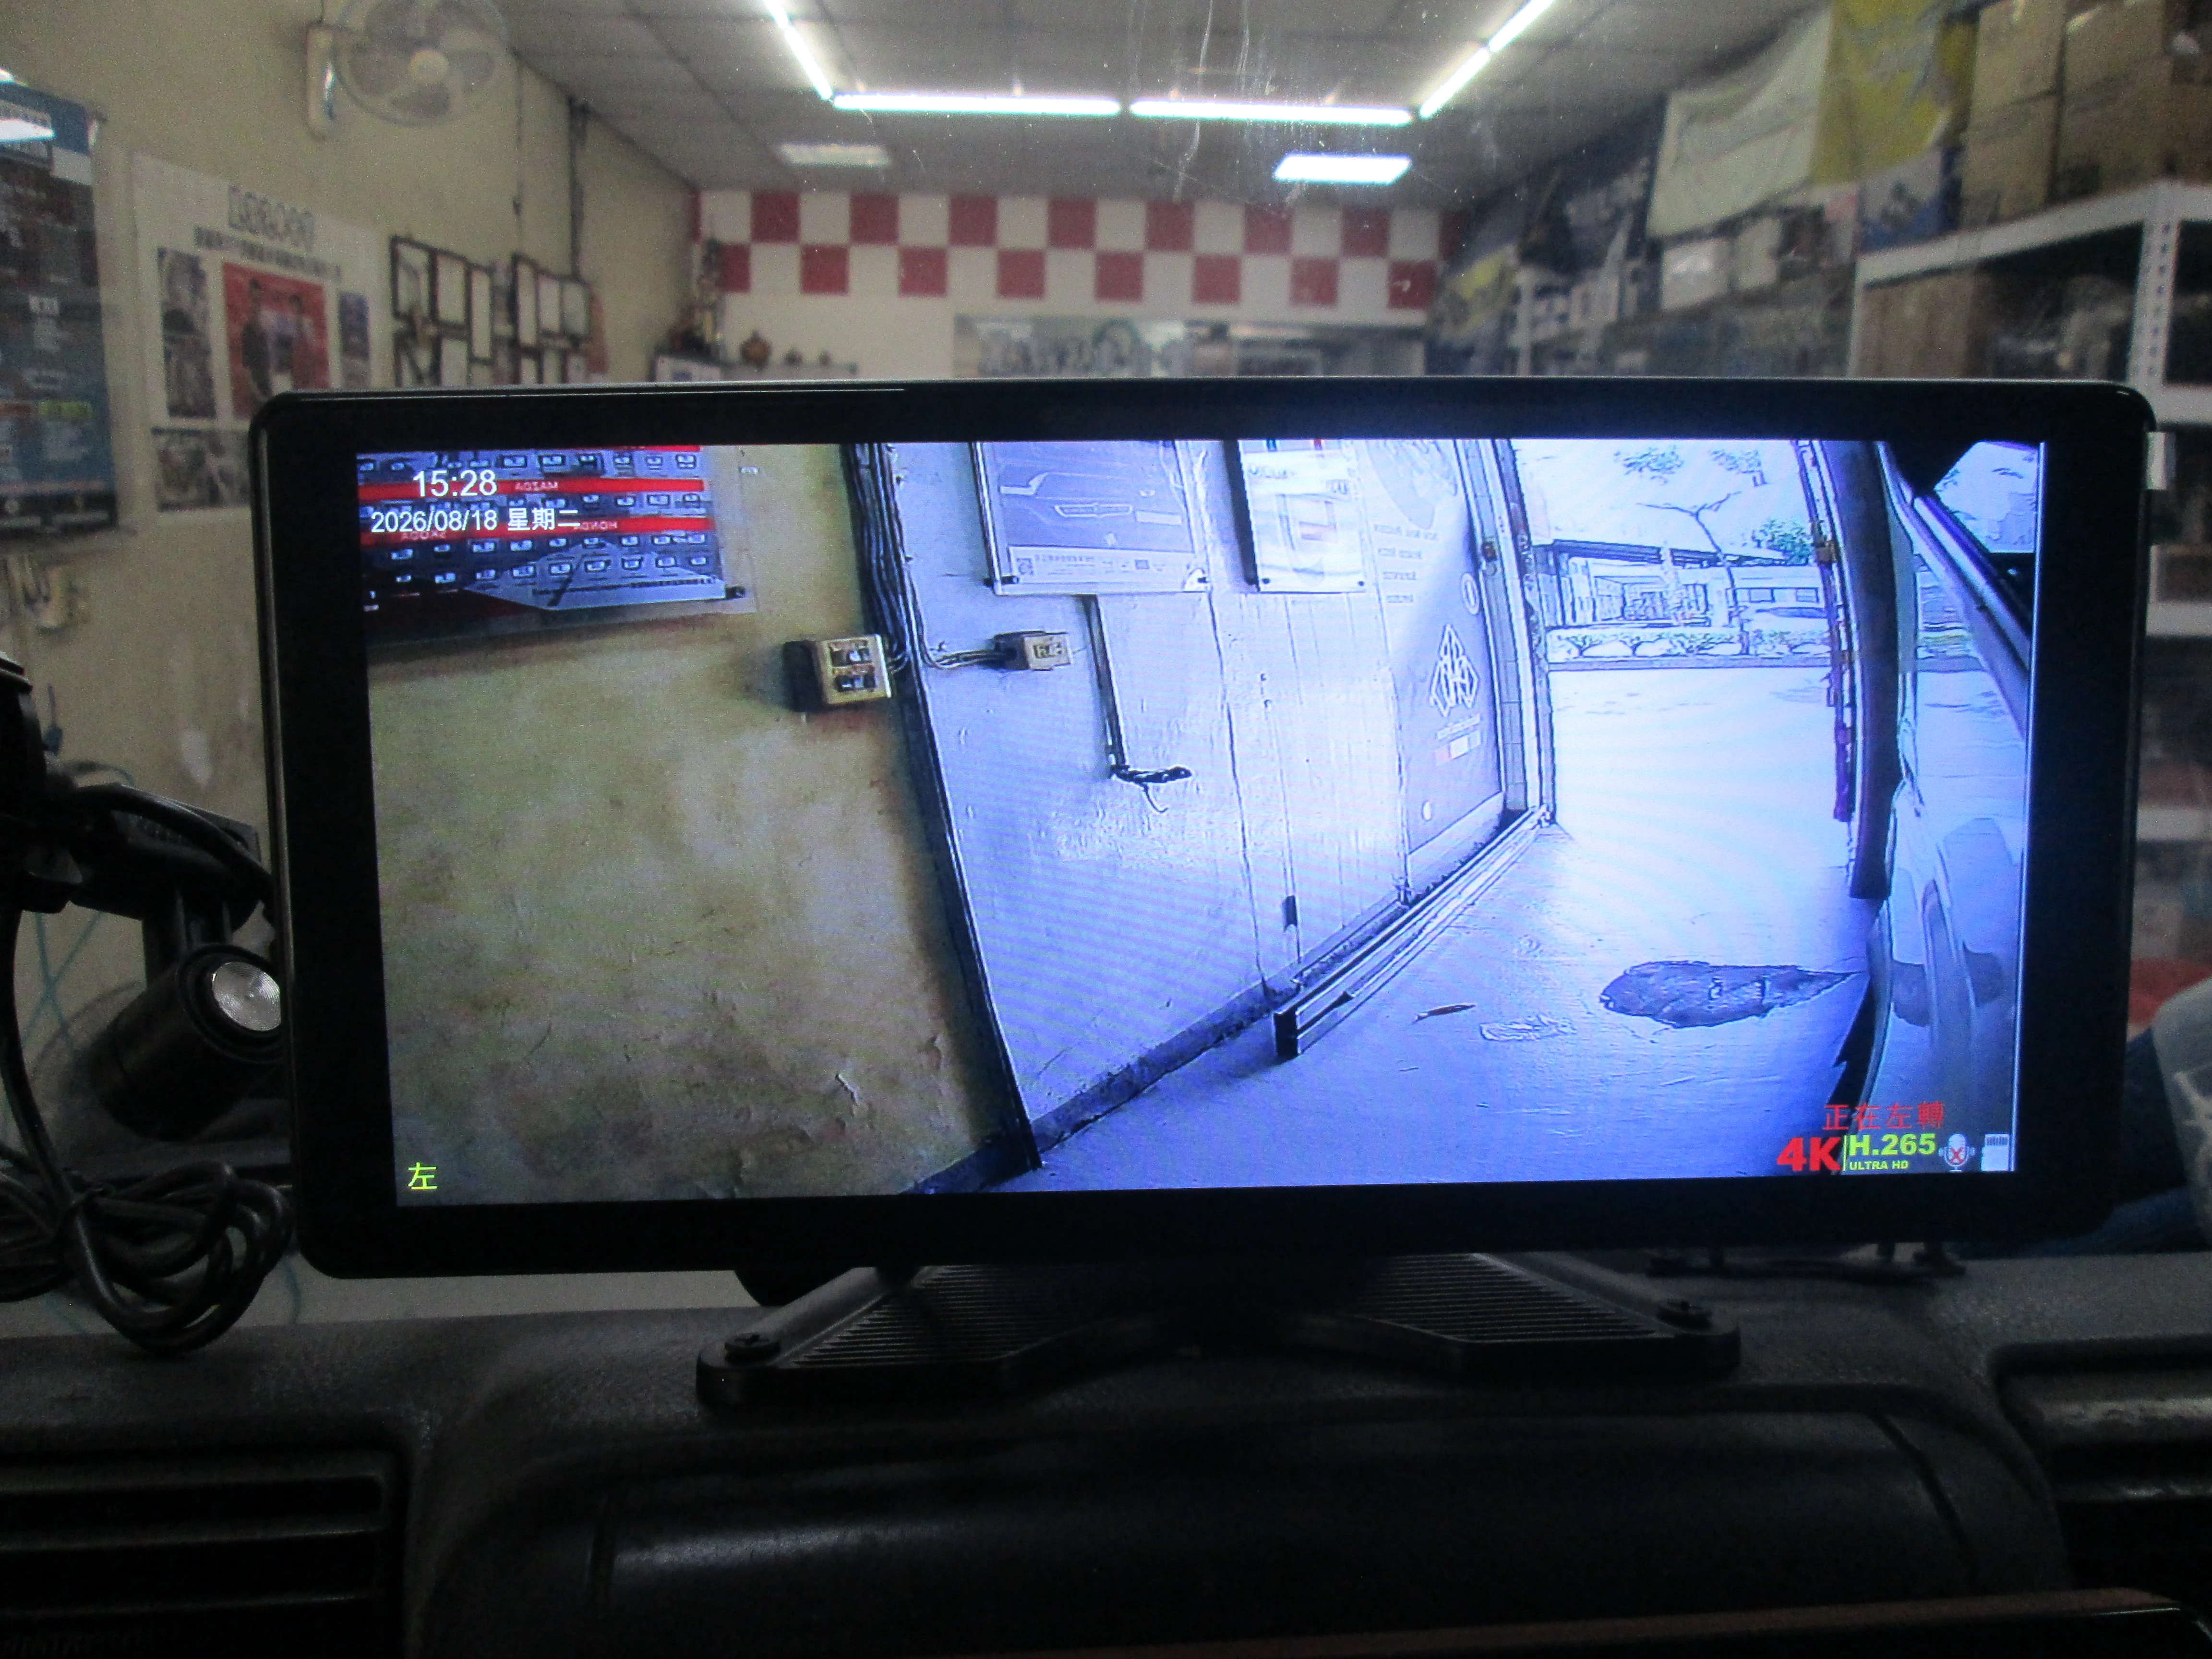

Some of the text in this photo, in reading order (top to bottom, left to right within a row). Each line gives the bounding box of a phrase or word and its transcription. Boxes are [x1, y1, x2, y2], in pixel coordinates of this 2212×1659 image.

[413, 469, 497, 497] 15:28
[371, 507, 581, 532] 2026/08/18 星期二
[1822, 1101, 1945, 1130] 正在左轉
[1777, 1137, 1841, 1172] 4K
[1850, 1133, 1936, 1156] H.265
[408, 1162, 438, 1190] 左
[1850, 1160, 1909, 1171] ULTRA HD
